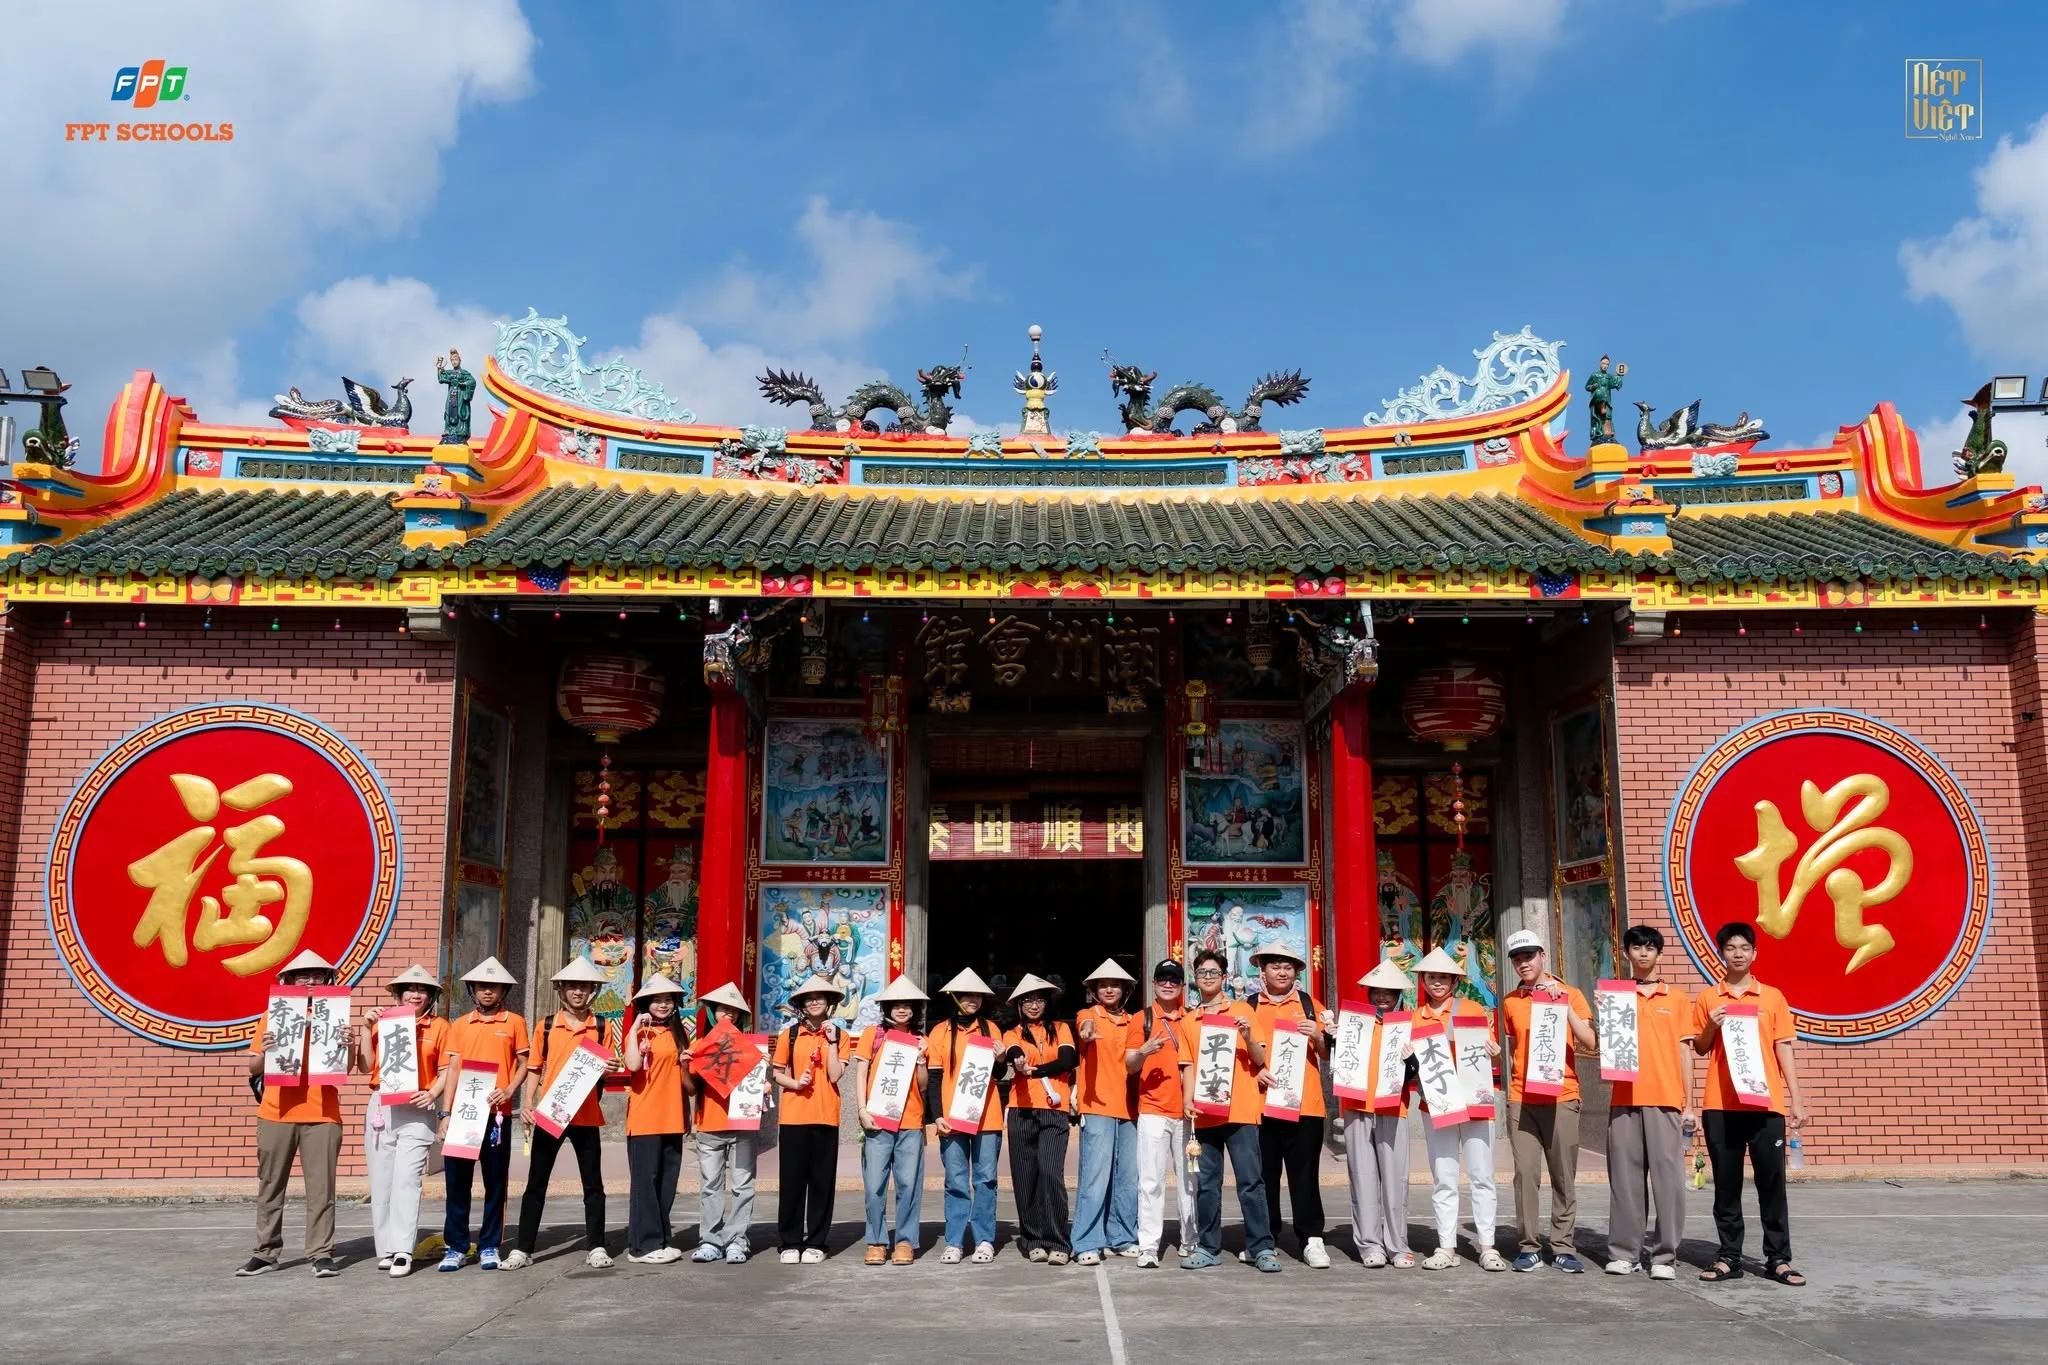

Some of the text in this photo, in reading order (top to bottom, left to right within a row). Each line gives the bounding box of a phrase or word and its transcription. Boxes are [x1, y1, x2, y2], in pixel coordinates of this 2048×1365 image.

[127, 772, 314, 977] 福
[380, 1023, 417, 1077] 康
[880, 1050, 905, 1097] 幸福
[1198, 1033, 1233, 1099] 平安
[457, 1076, 484, 1121] 幸福
[958, 1061, 990, 1100] 福
